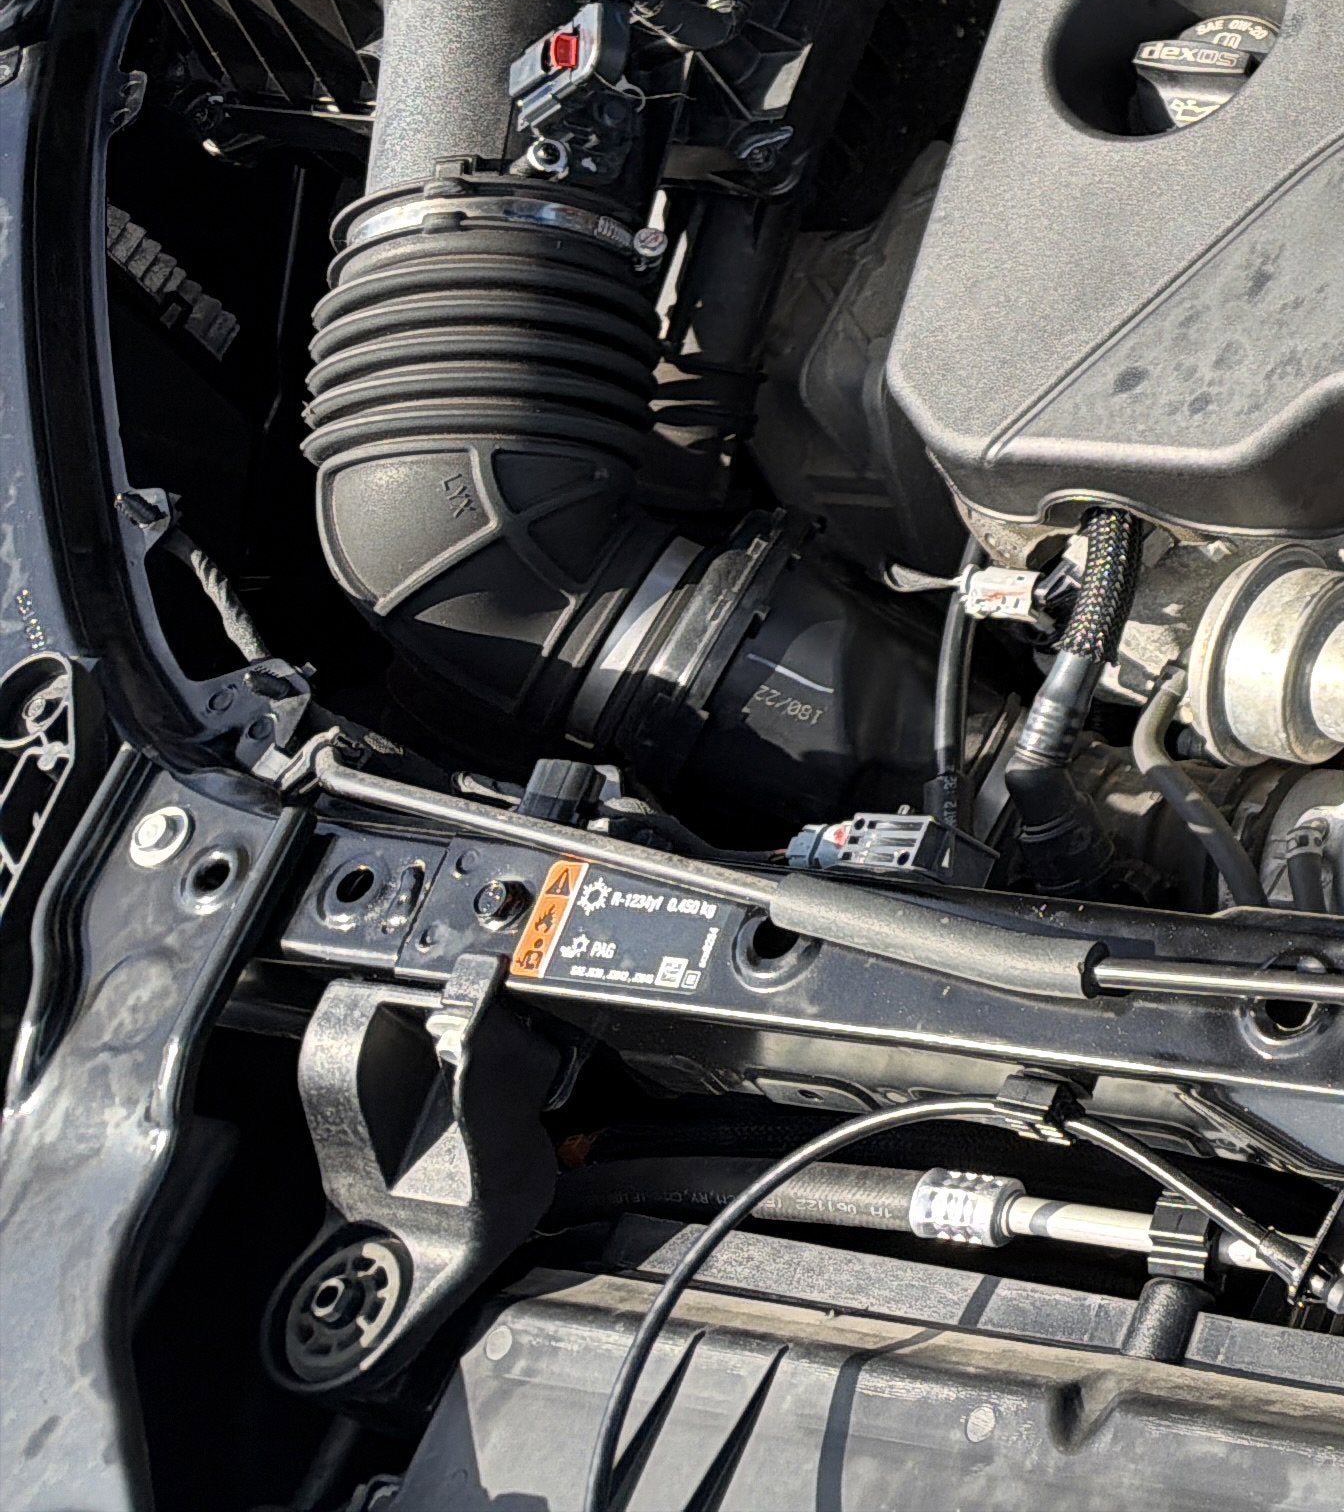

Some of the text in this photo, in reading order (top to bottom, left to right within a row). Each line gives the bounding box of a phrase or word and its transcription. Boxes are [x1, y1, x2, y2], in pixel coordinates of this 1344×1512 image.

[1196, 20, 1224, 35] SAE
[1140, 43, 1240, 67] dexos
[590, 942, 617, 959] PAG
